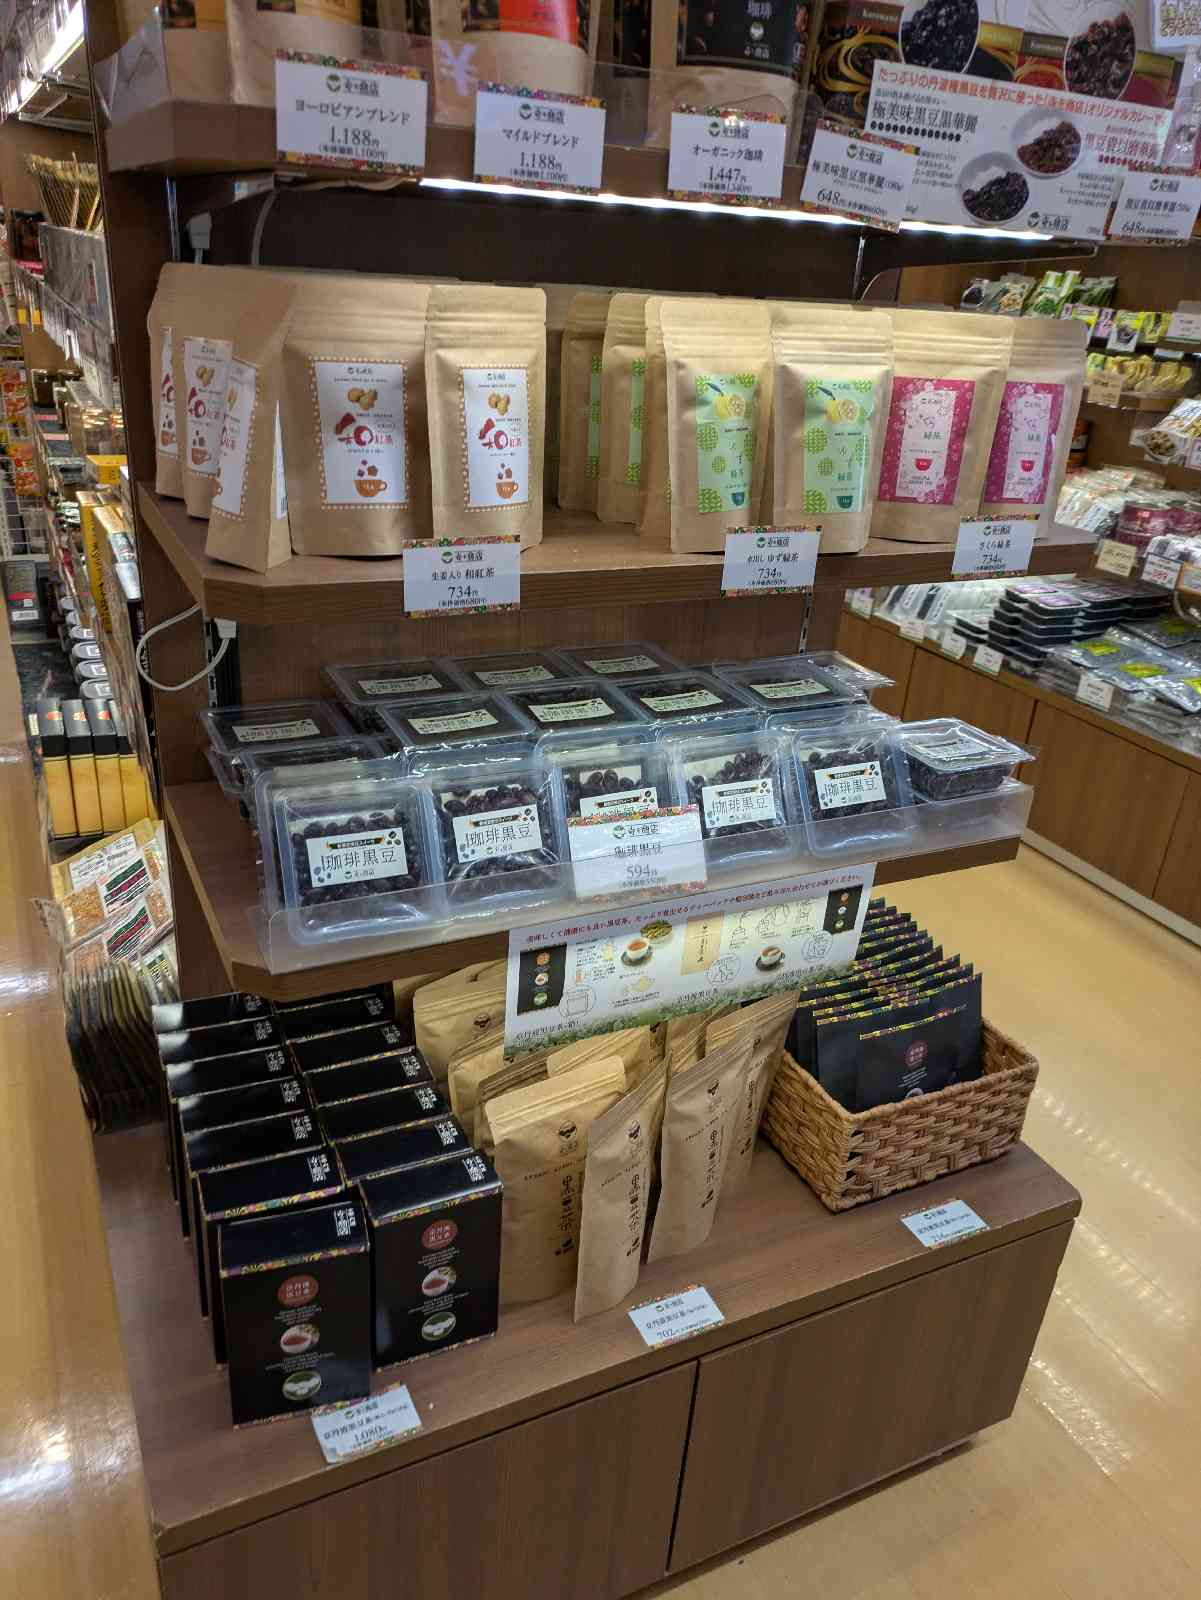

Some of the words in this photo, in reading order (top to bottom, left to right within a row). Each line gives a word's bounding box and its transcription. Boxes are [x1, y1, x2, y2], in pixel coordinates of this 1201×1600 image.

[295, 99, 411, 125] ヨーロピアンブレンド
[502, 128, 580, 150] マイルドブレンド
[691, 143, 764, 162] オーガニック珈琲
[447, 585, 479, 600] 734円
[823, 777, 878, 799] 珈琲黒豆
[712, 795, 769, 819] 珈琲黒豆
[464, 823, 534, 850] 珈琲黒豆
[320, 846, 400, 873] 珈琲黒豆
